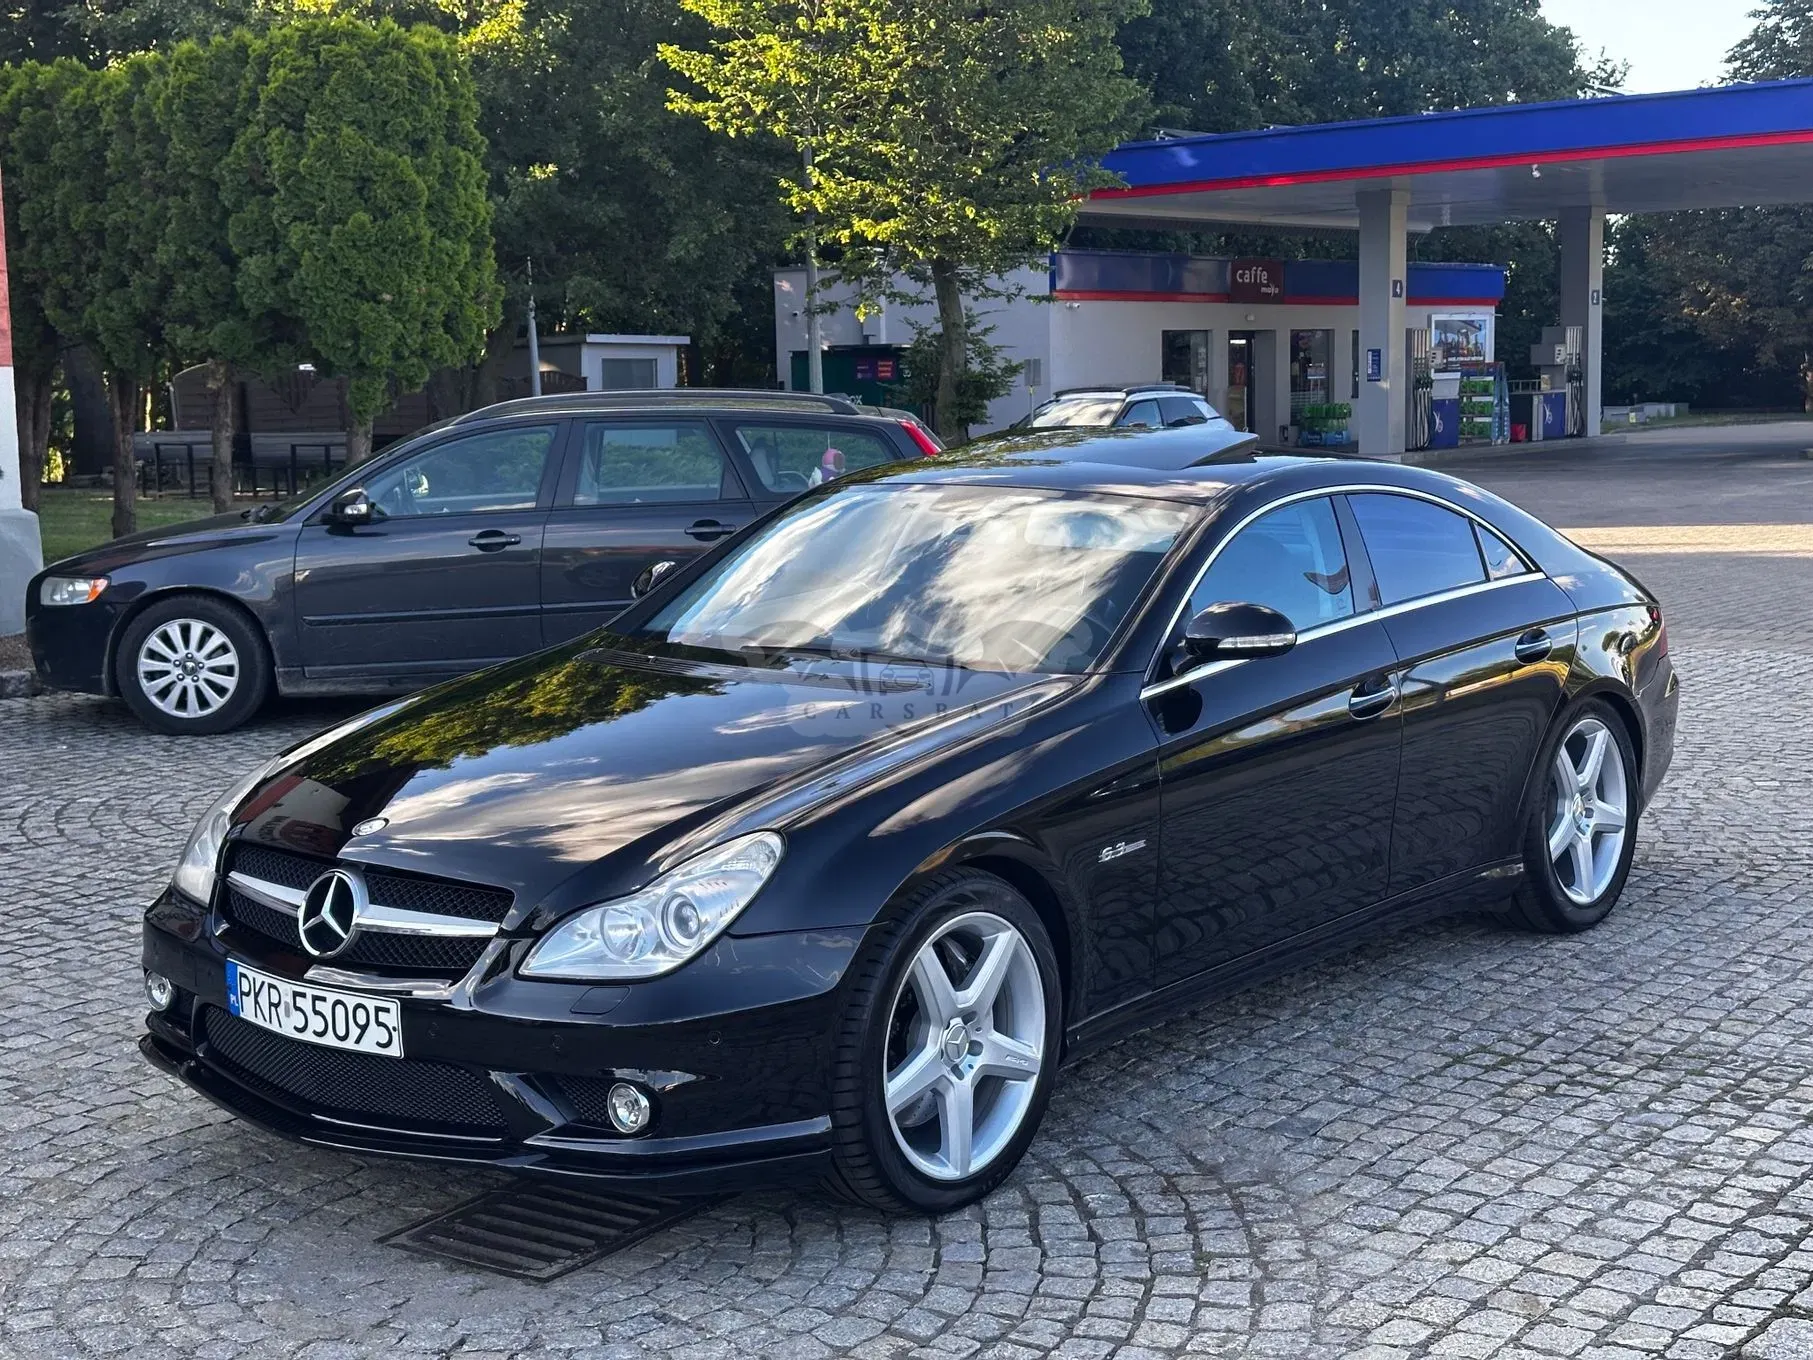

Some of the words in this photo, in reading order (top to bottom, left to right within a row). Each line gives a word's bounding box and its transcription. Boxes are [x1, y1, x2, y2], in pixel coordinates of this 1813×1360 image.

[1236, 266, 1268, 284] caffe
[1396, 282, 1401, 295] 4
[230, 993, 239, 1006] PL
[239, 971, 283, 1029] PKR
[292, 990, 393, 1049] 55095
